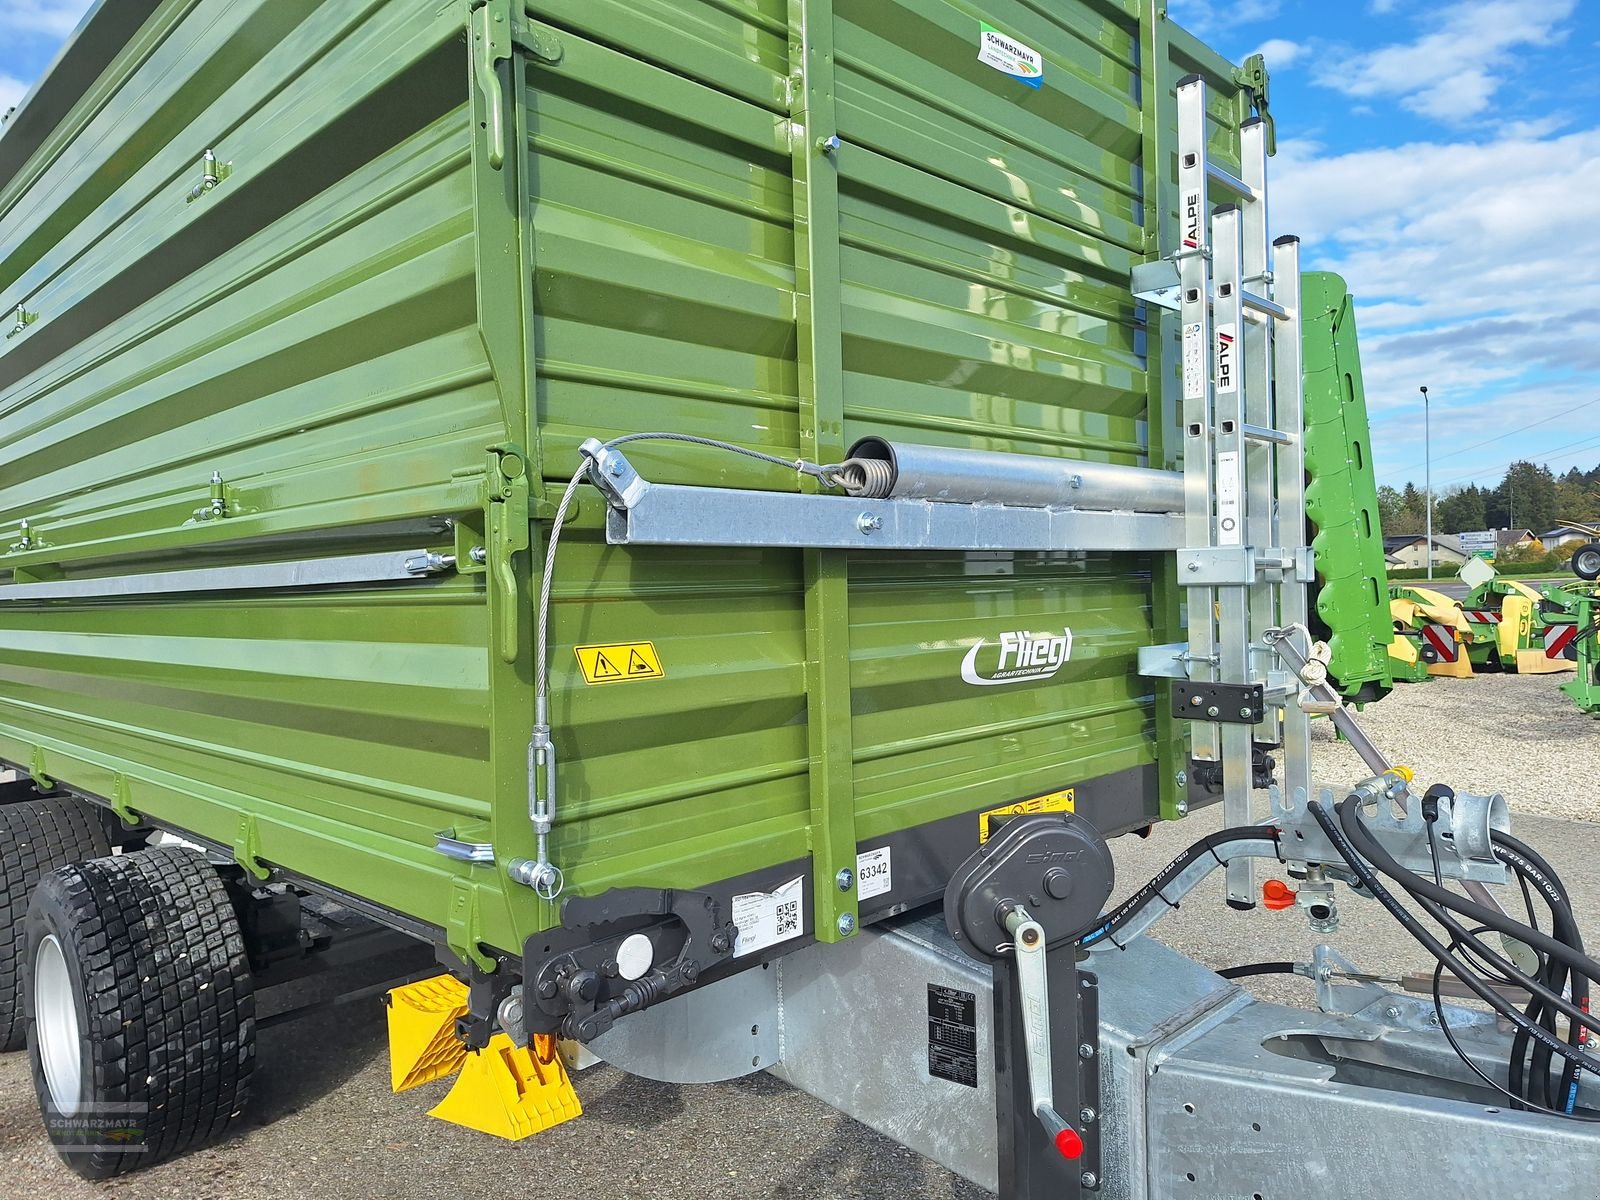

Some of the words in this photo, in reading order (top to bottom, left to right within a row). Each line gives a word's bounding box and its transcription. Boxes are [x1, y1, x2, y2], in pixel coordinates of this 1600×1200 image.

[987, 33, 1034, 64] SCHWARZMAYR
[998, 627, 1073, 671] Fliegl
[991, 667, 1043, 679] AGRARTECHNIK
[860, 862, 888, 881] 63342
[1165, 862, 1175, 874] BAR
[1508, 854, 1524, 865] 275
[1525, 864, 1542, 880] BAR
[1542, 1036, 1560, 1050] MADE
